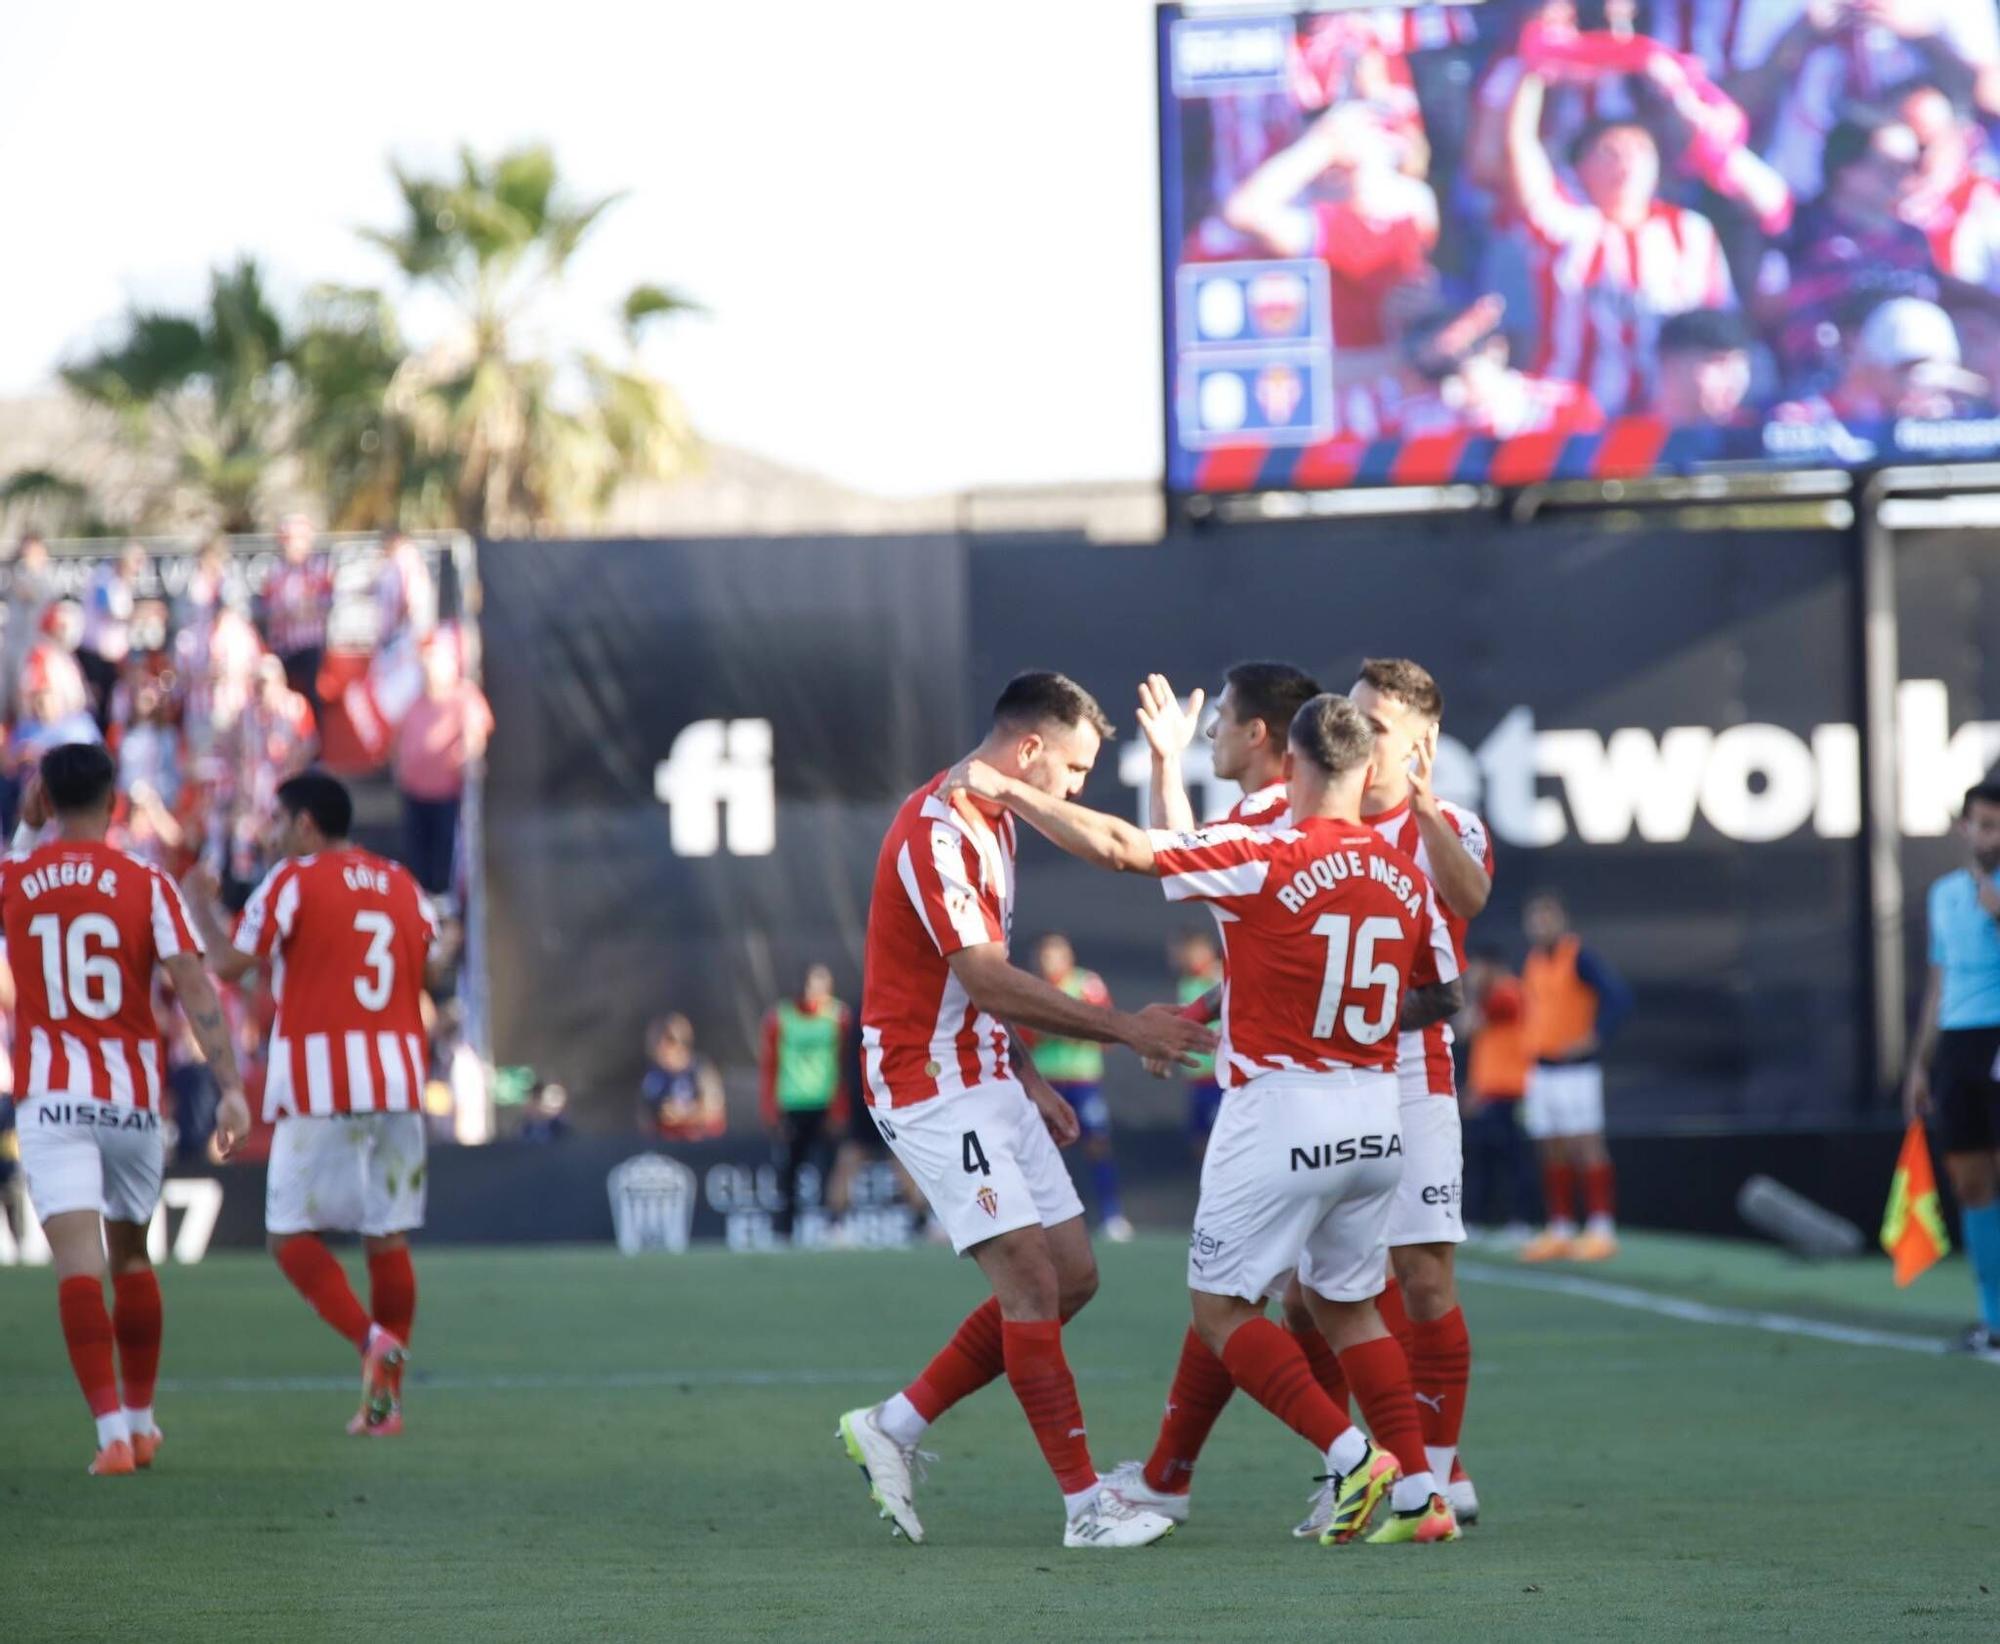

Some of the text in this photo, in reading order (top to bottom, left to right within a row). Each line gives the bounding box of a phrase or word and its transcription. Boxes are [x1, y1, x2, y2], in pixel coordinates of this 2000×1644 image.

[654, 718, 776, 857] fi
[21, 861, 94, 900] DIEGO
[1276, 850, 1422, 919] ROQUE MESA
[28, 912, 123, 1020] 16
[353, 909, 396, 1012] 3
[1311, 913, 1404, 1045] 15
[962, 1130, 991, 1176] 4
[1291, 1134, 1403, 1171] NISSA
